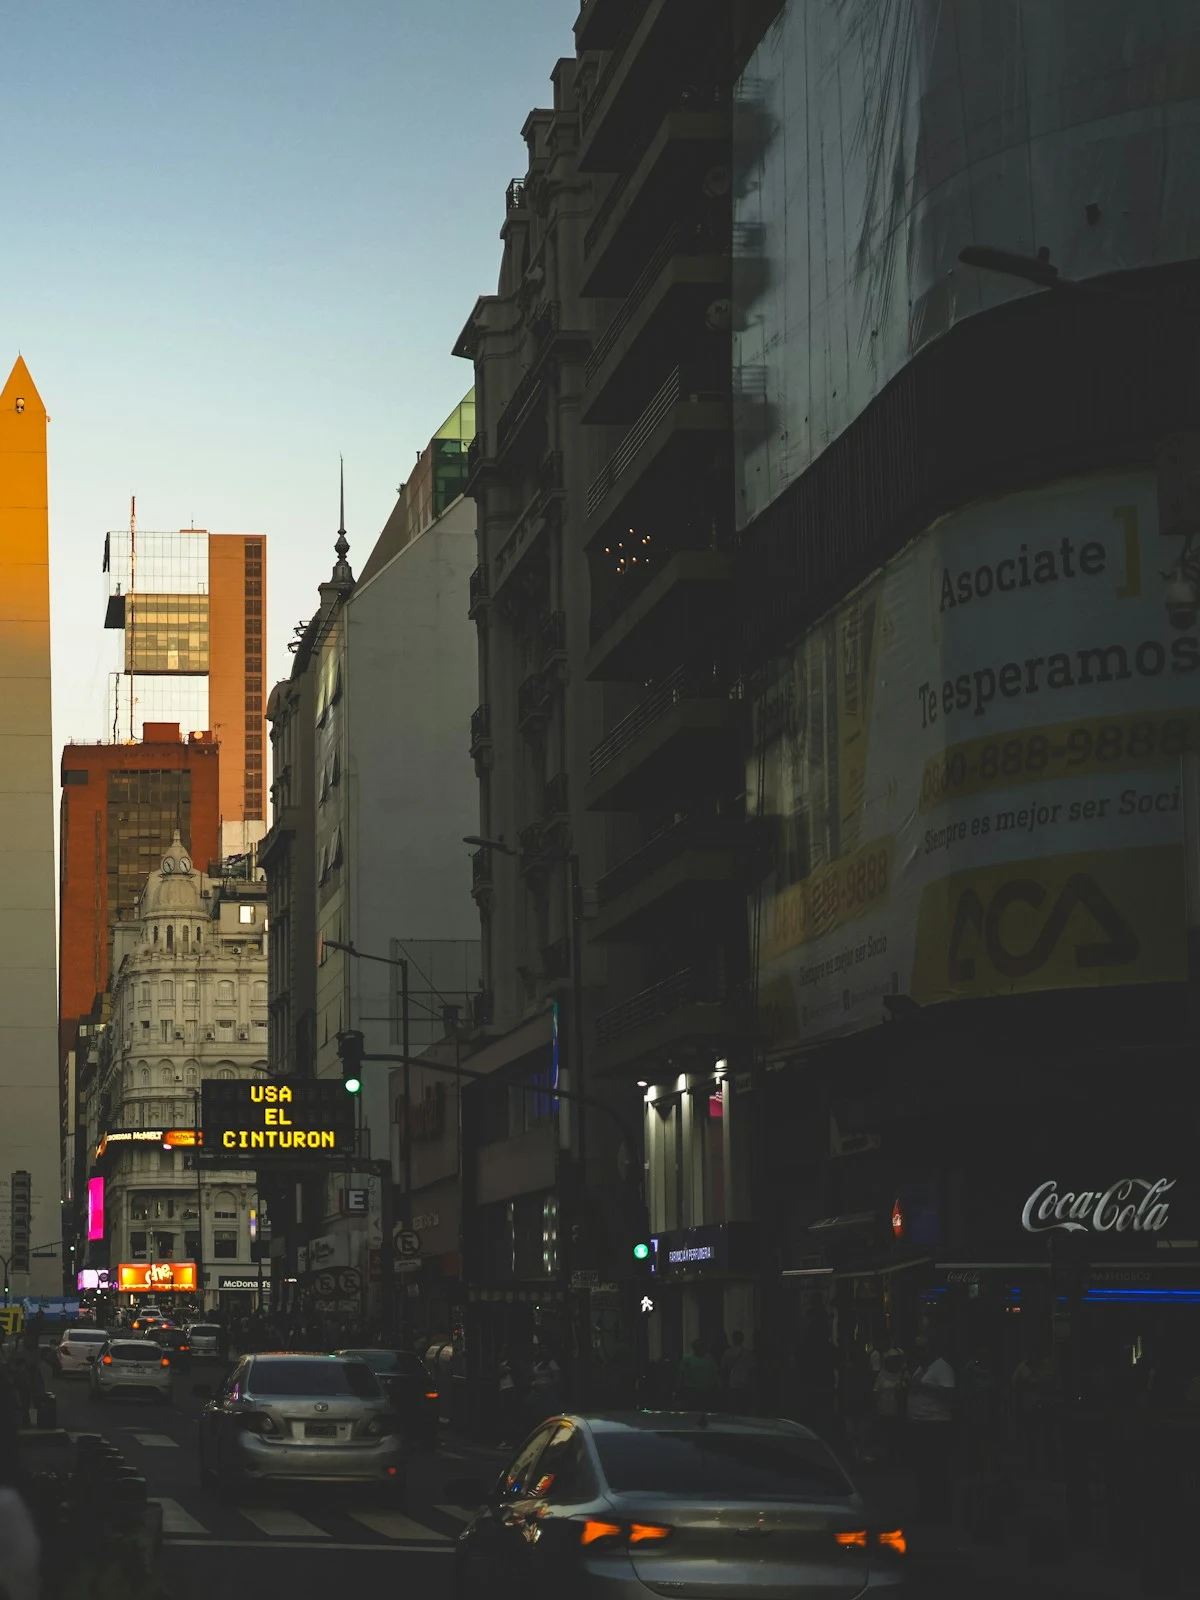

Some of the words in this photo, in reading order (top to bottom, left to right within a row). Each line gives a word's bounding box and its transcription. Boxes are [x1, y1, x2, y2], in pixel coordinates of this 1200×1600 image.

[940, 537, 1106, 611] Asociate
[918, 682, 939, 728] Te
[941, 636, 1200, 716] esperamos
[924, 822, 968, 856] Siempre
[970, 817, 991, 836] es
[995, 804, 1061, 833] mejor
[1068, 799, 1110, 822] ser
[251, 1086, 292, 1103] USA
[265, 1108, 292, 1125] EL
[223, 1131, 334, 1149] CINTURON
[1022, 1178, 1176, 1232] Coca-Cola
